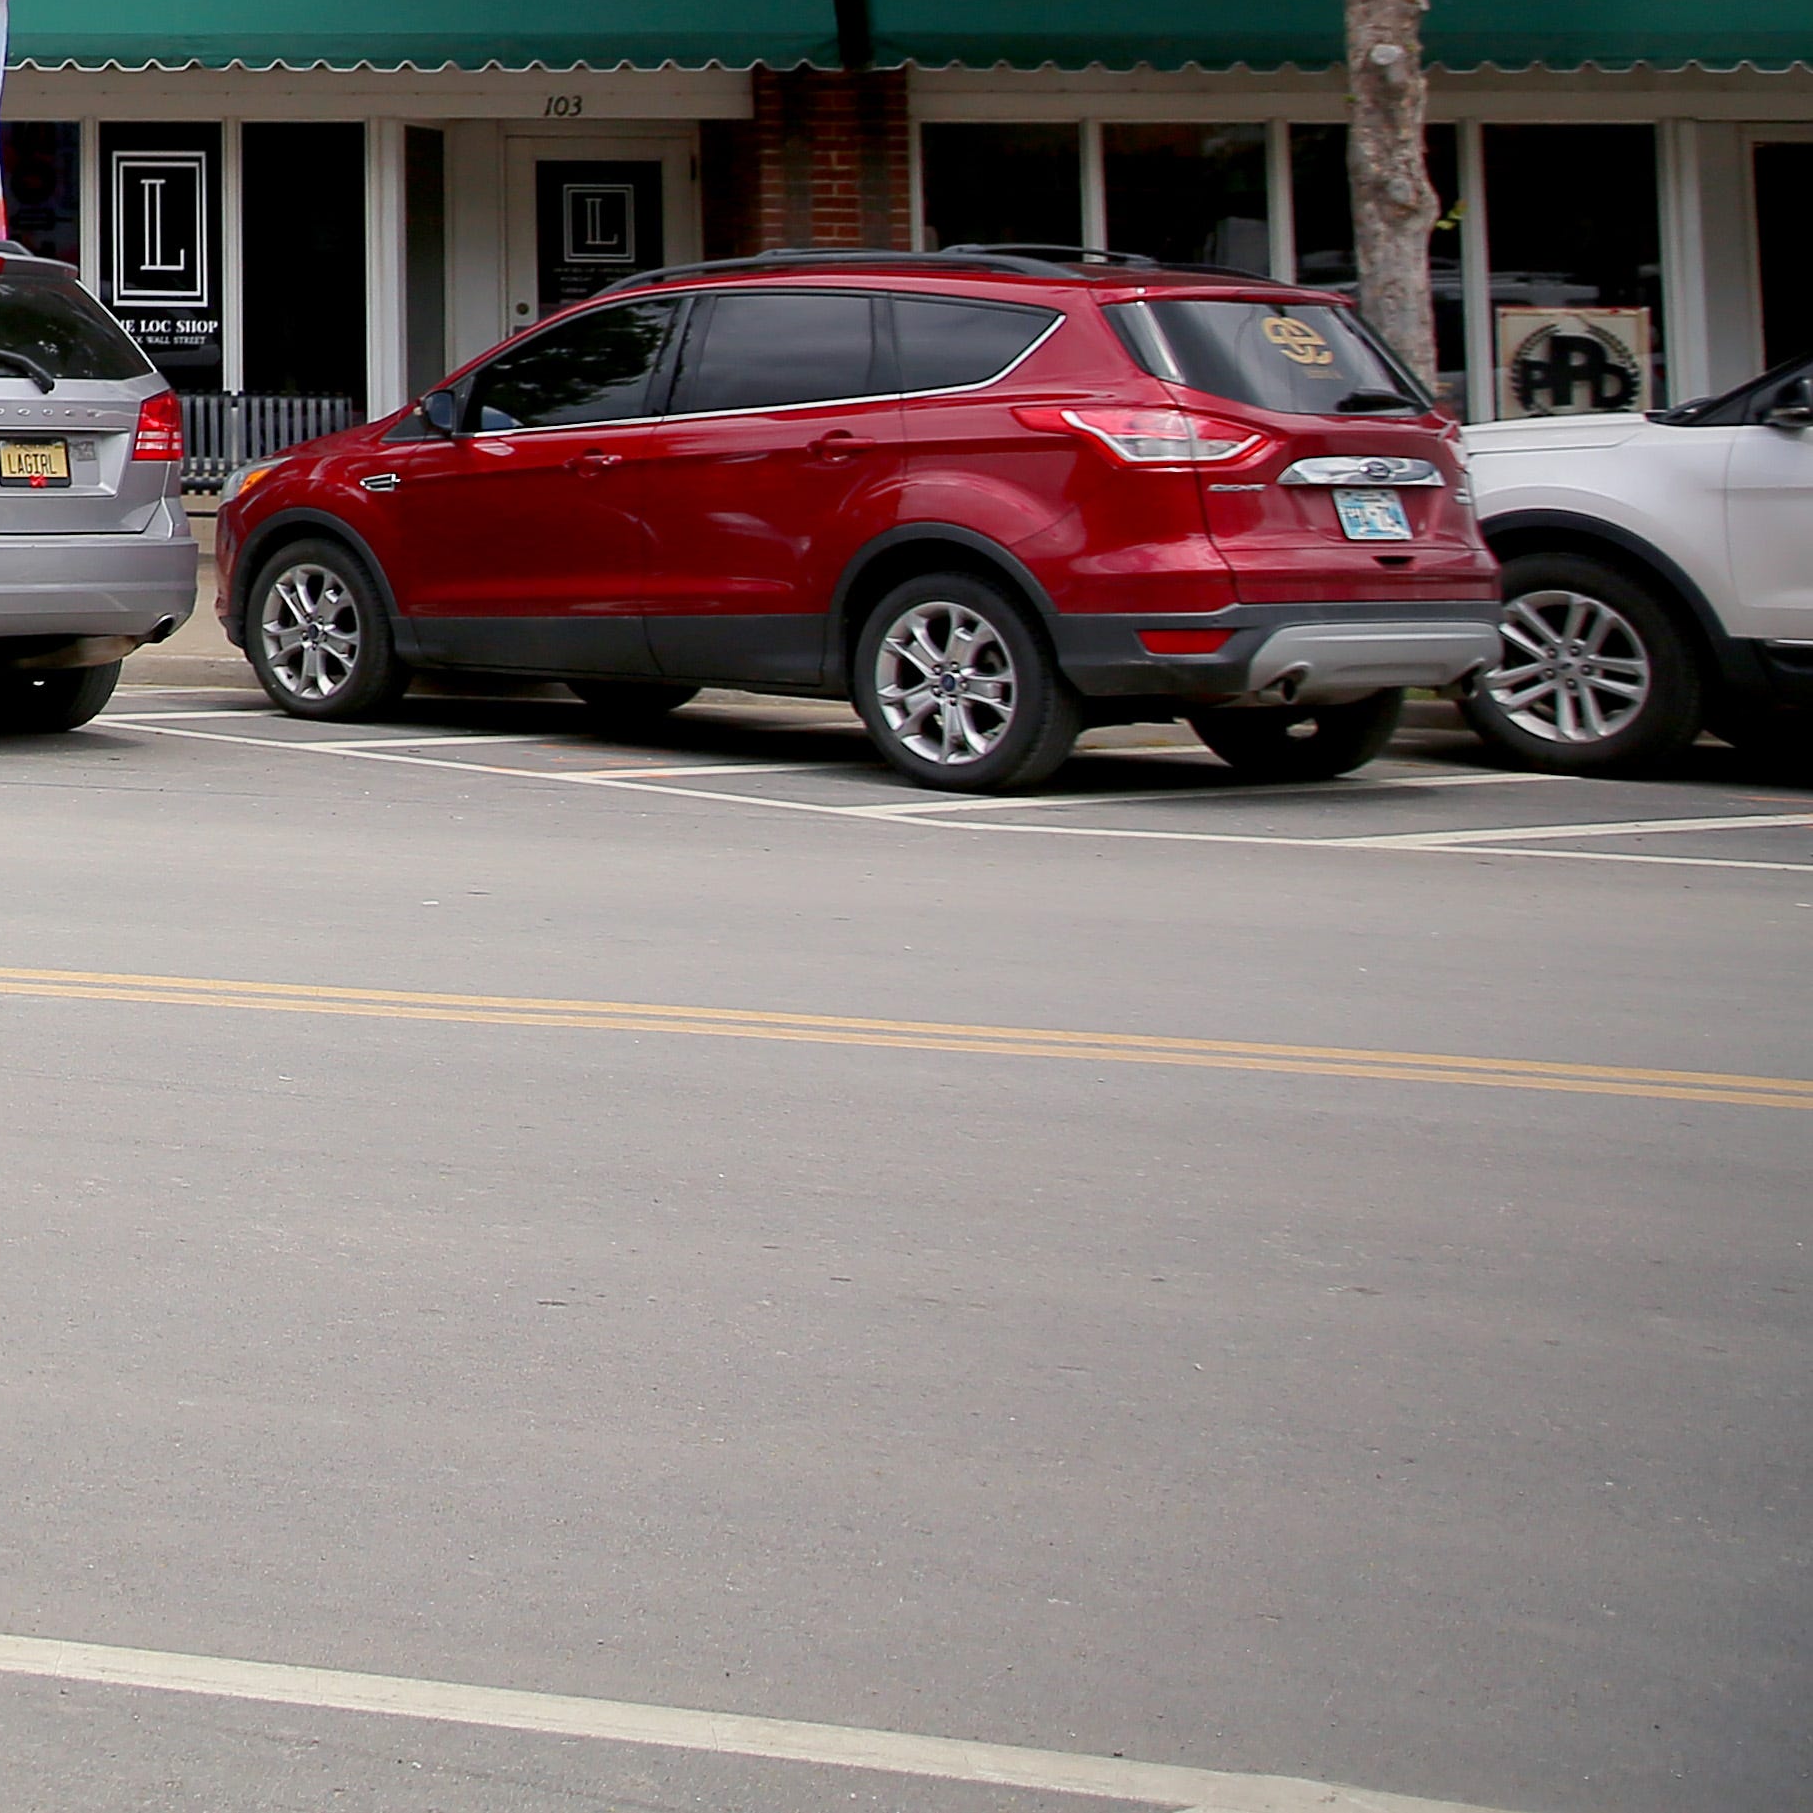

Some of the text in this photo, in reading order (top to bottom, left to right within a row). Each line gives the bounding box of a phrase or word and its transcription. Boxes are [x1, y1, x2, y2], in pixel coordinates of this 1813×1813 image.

[544, 95, 583, 117] 103
[140, 319, 172, 334] LOC
[175, 319, 219, 334] SHOP
[7, 452, 58, 476] LAGIRL
